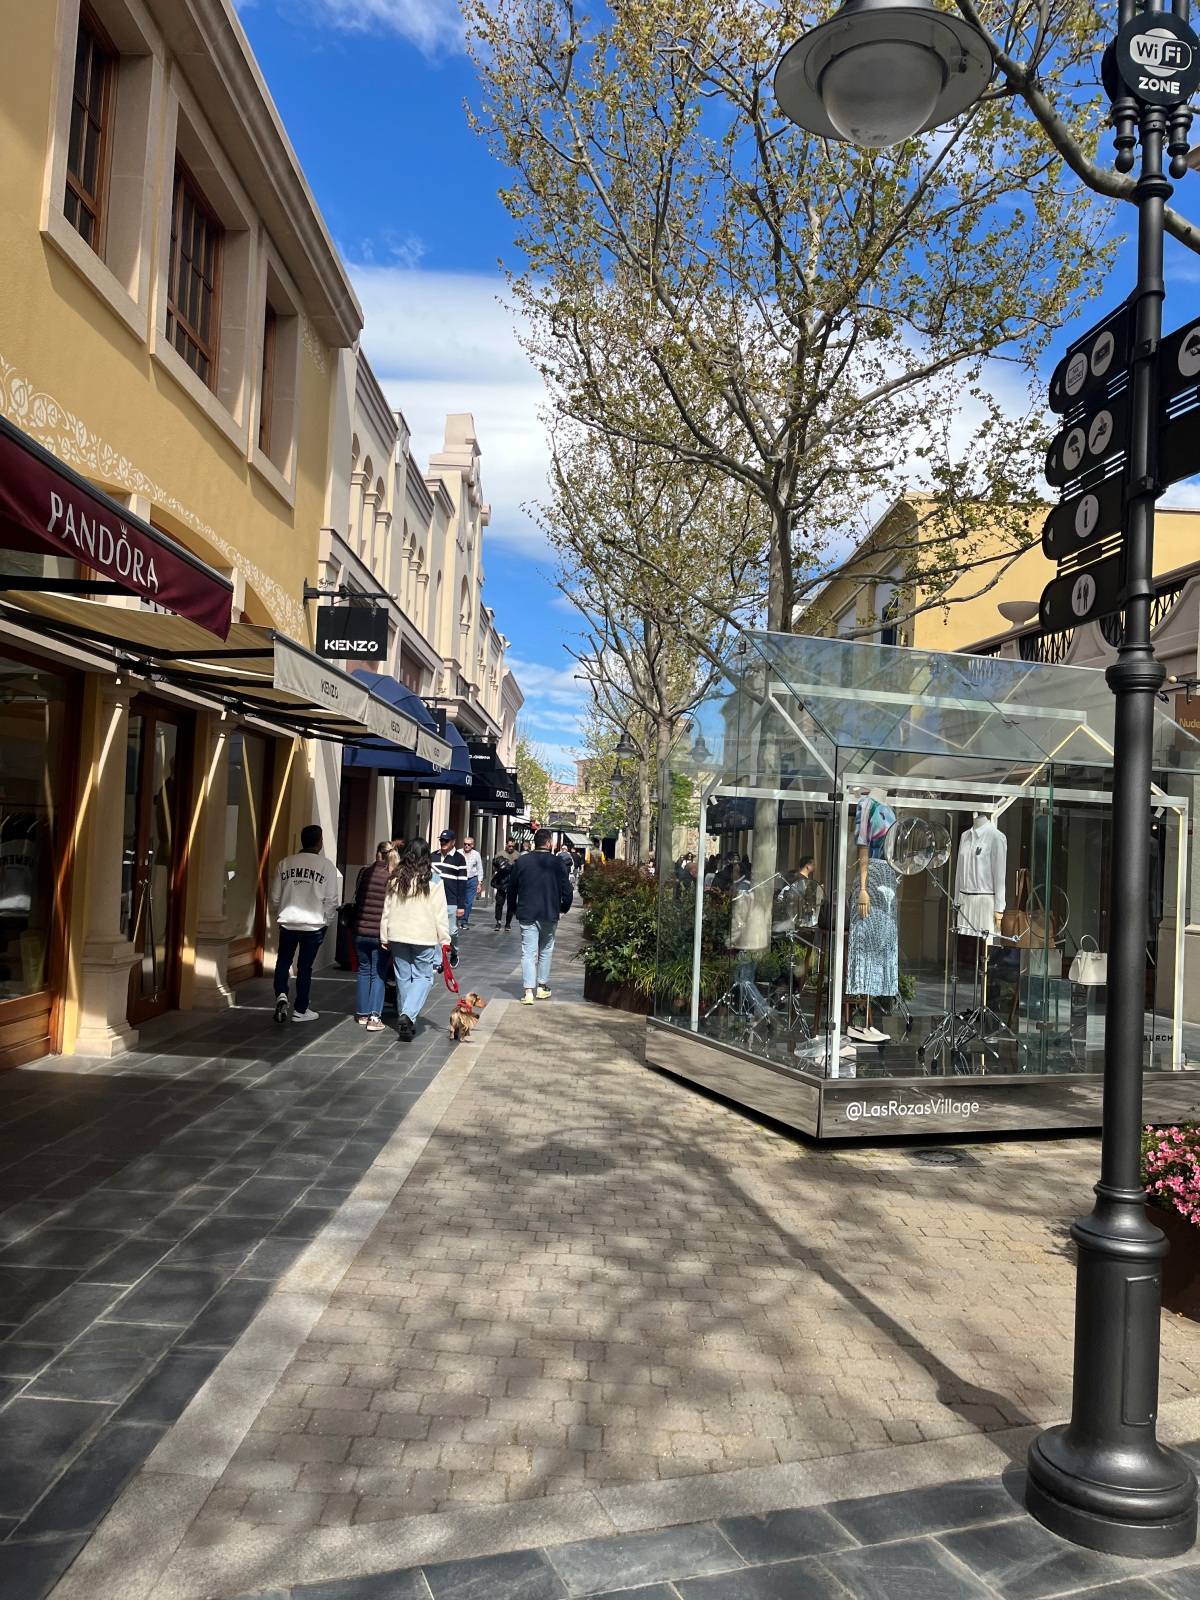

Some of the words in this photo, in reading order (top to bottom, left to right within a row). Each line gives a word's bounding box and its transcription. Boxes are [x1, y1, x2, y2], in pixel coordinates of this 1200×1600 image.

[1139, 77, 1181, 94] ZONE
[47, 491, 159, 594] PANDORA
[324, 639, 379, 652] KENZO
[320, 679, 339, 700] KENZO
[281, 868, 325, 884] CLEMENTE
[846, 1099, 980, 1121] @LasRozasVillage
